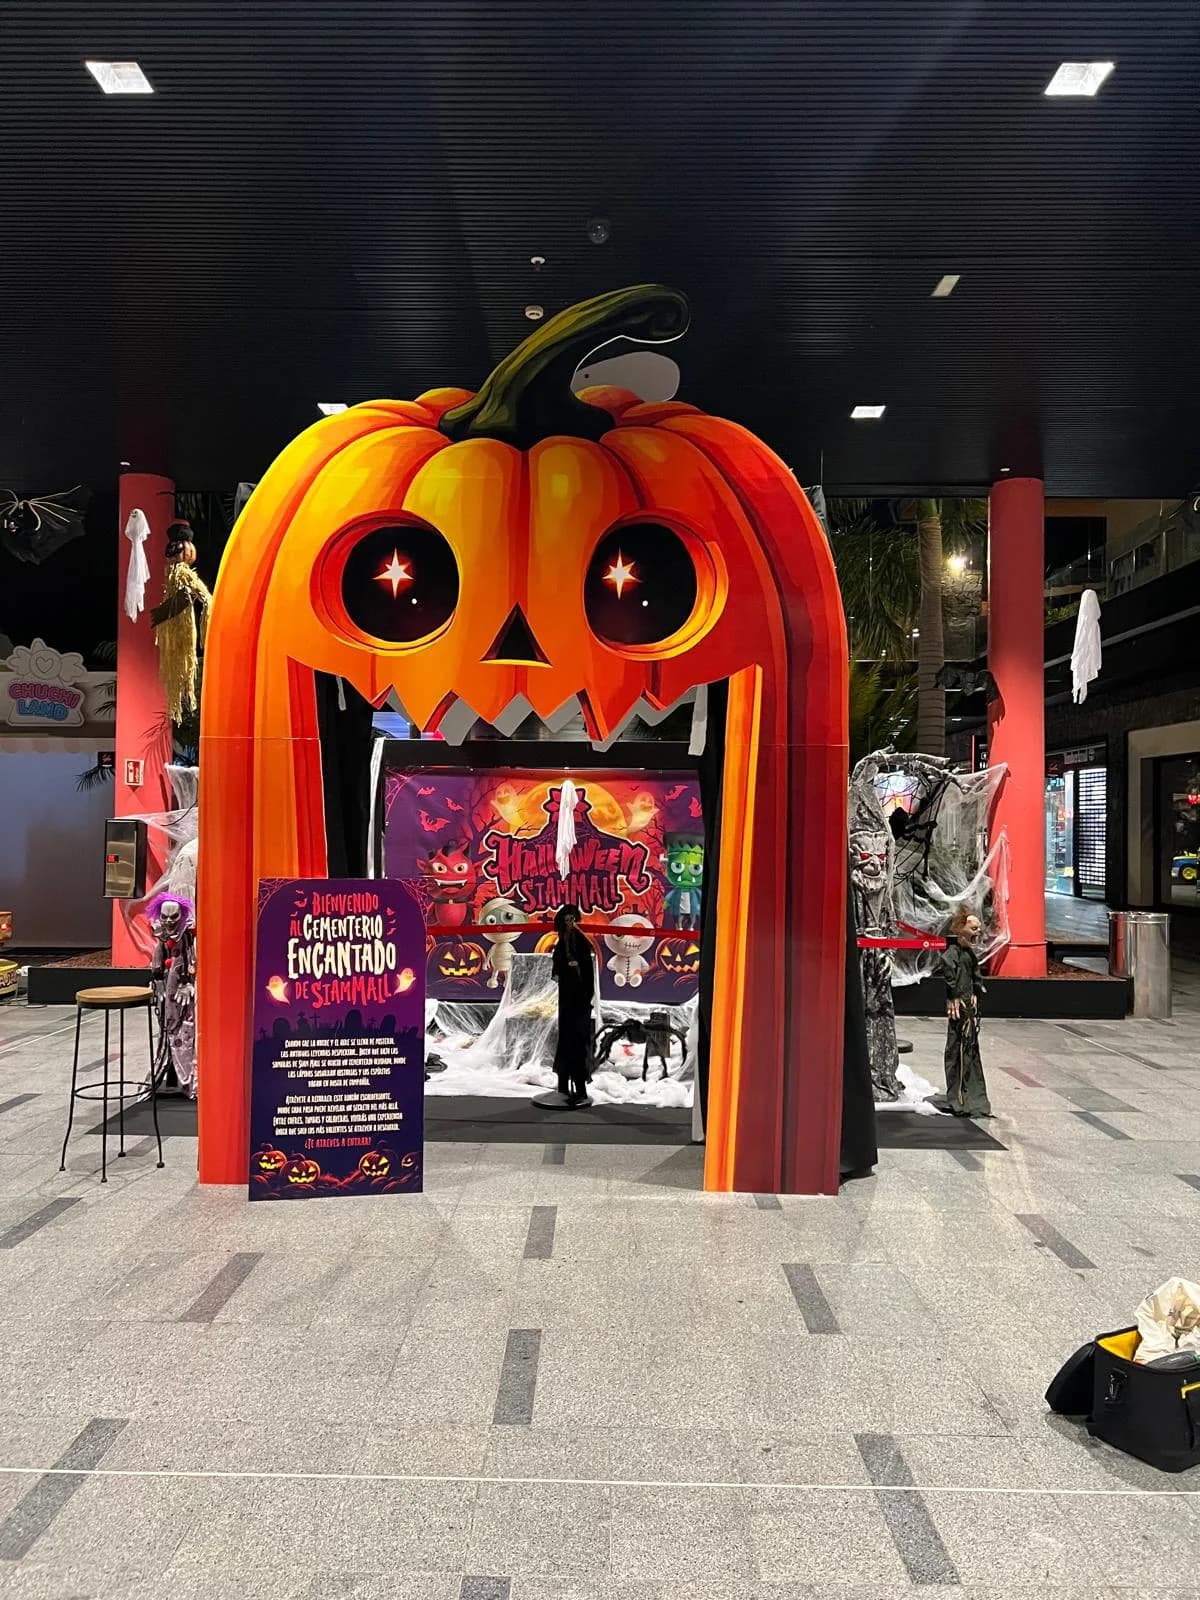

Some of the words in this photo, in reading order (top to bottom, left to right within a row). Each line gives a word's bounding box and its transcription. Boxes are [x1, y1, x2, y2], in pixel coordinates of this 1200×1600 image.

[9, 683, 80, 708] CHUCHI
[16, 699, 70, 721] LAND
[485, 833, 650, 892] HALLWEEN
[312, 891, 379, 915] BIENVENIDO
[290, 919, 302, 937] AL
[303, 914, 383, 941] CEMENTERIO
[287, 938, 397, 980] ENCANTADO
[295, 981, 309, 1000] DE
